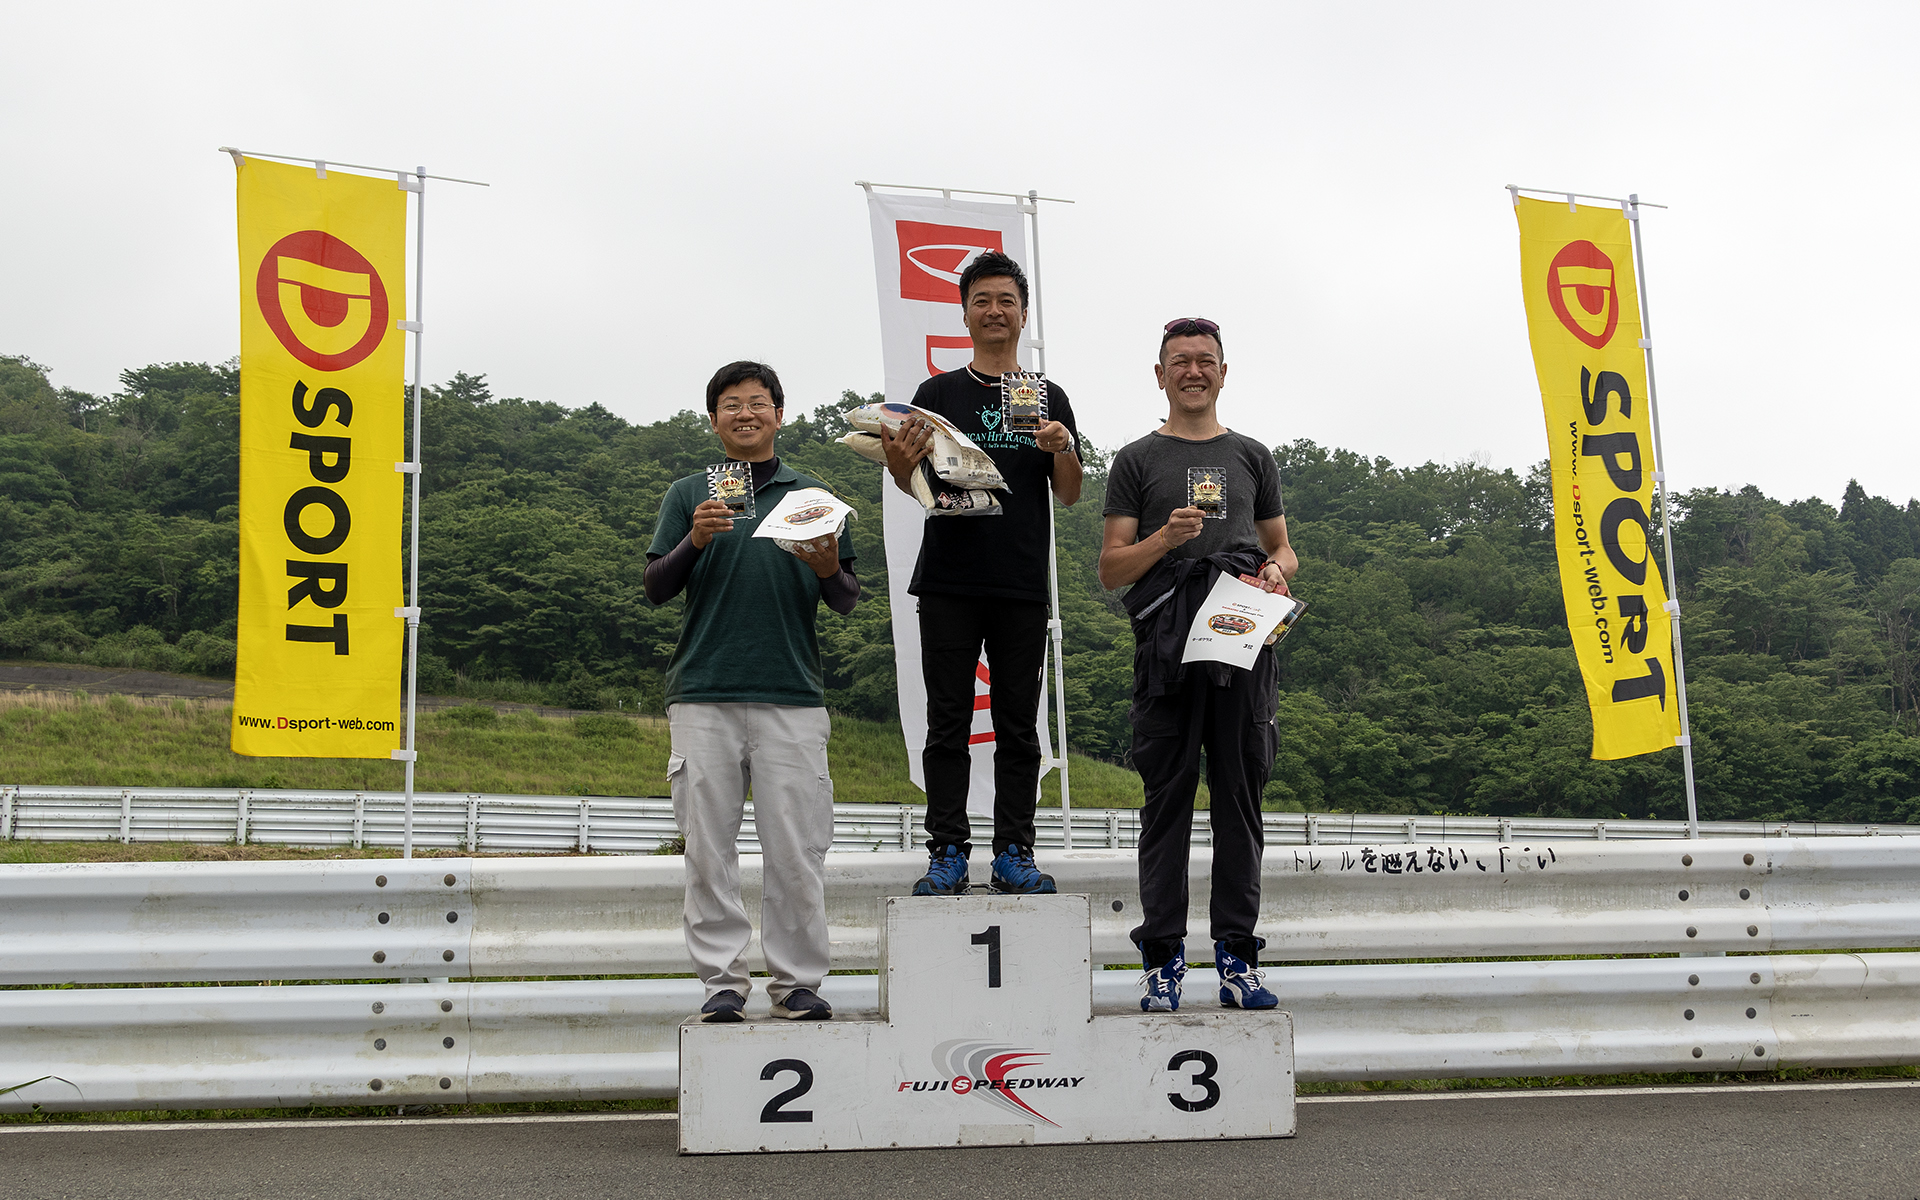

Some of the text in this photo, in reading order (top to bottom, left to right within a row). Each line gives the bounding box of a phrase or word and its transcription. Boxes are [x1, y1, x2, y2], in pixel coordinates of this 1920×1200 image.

[987, 431, 1004, 442] HIT
[1004, 431, 1037, 448] RACING
[284, 379, 353, 655] SPORT
[1568, 420, 1615, 664] www.Dsport-web.com
[1580, 364, 1666, 713] SPORT
[238, 715, 395, 732] www.Dsport-web.com
[970, 926, 1001, 988] 1
[760, 1059, 813, 1123] 2
[898, 1077, 1085, 1092] FUJI SPEEDWAY
[1167, 1050, 1220, 1112] 3
